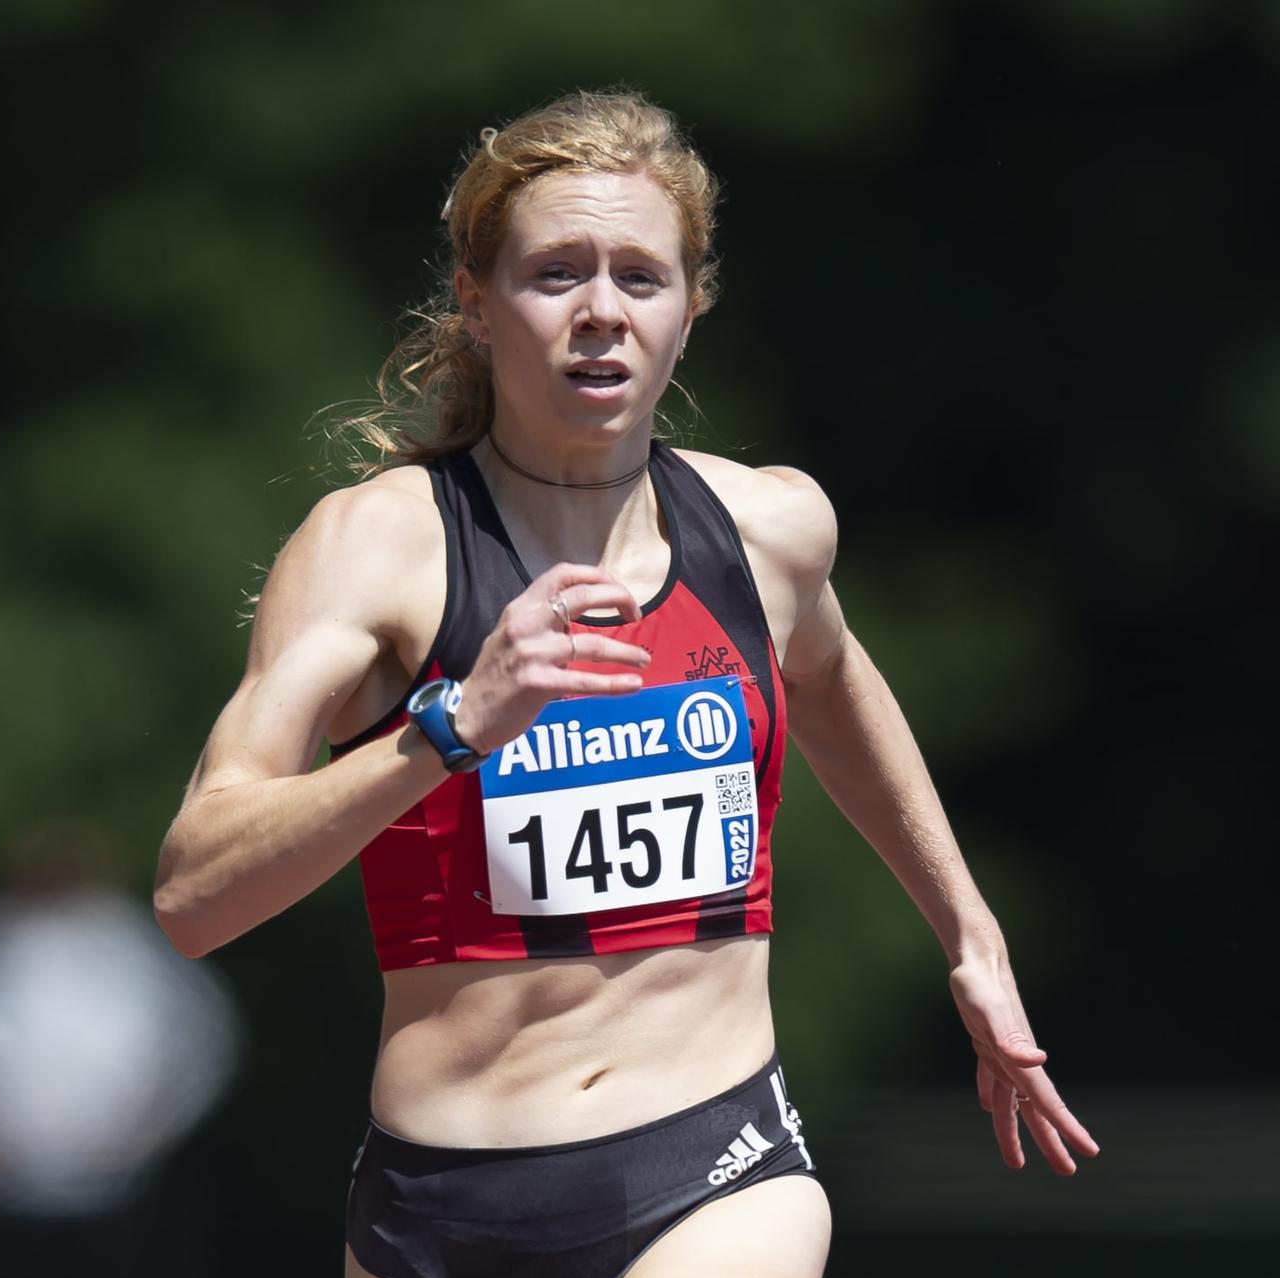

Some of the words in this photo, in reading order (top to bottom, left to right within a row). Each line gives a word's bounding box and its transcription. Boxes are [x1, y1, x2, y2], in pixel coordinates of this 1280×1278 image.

[686, 644, 729, 668] TAP
[497, 719, 669, 776] Allianz
[508, 793, 704, 900] 1457
[728, 818, 750, 879] 2022
[706, 1150, 762, 1186] adi
